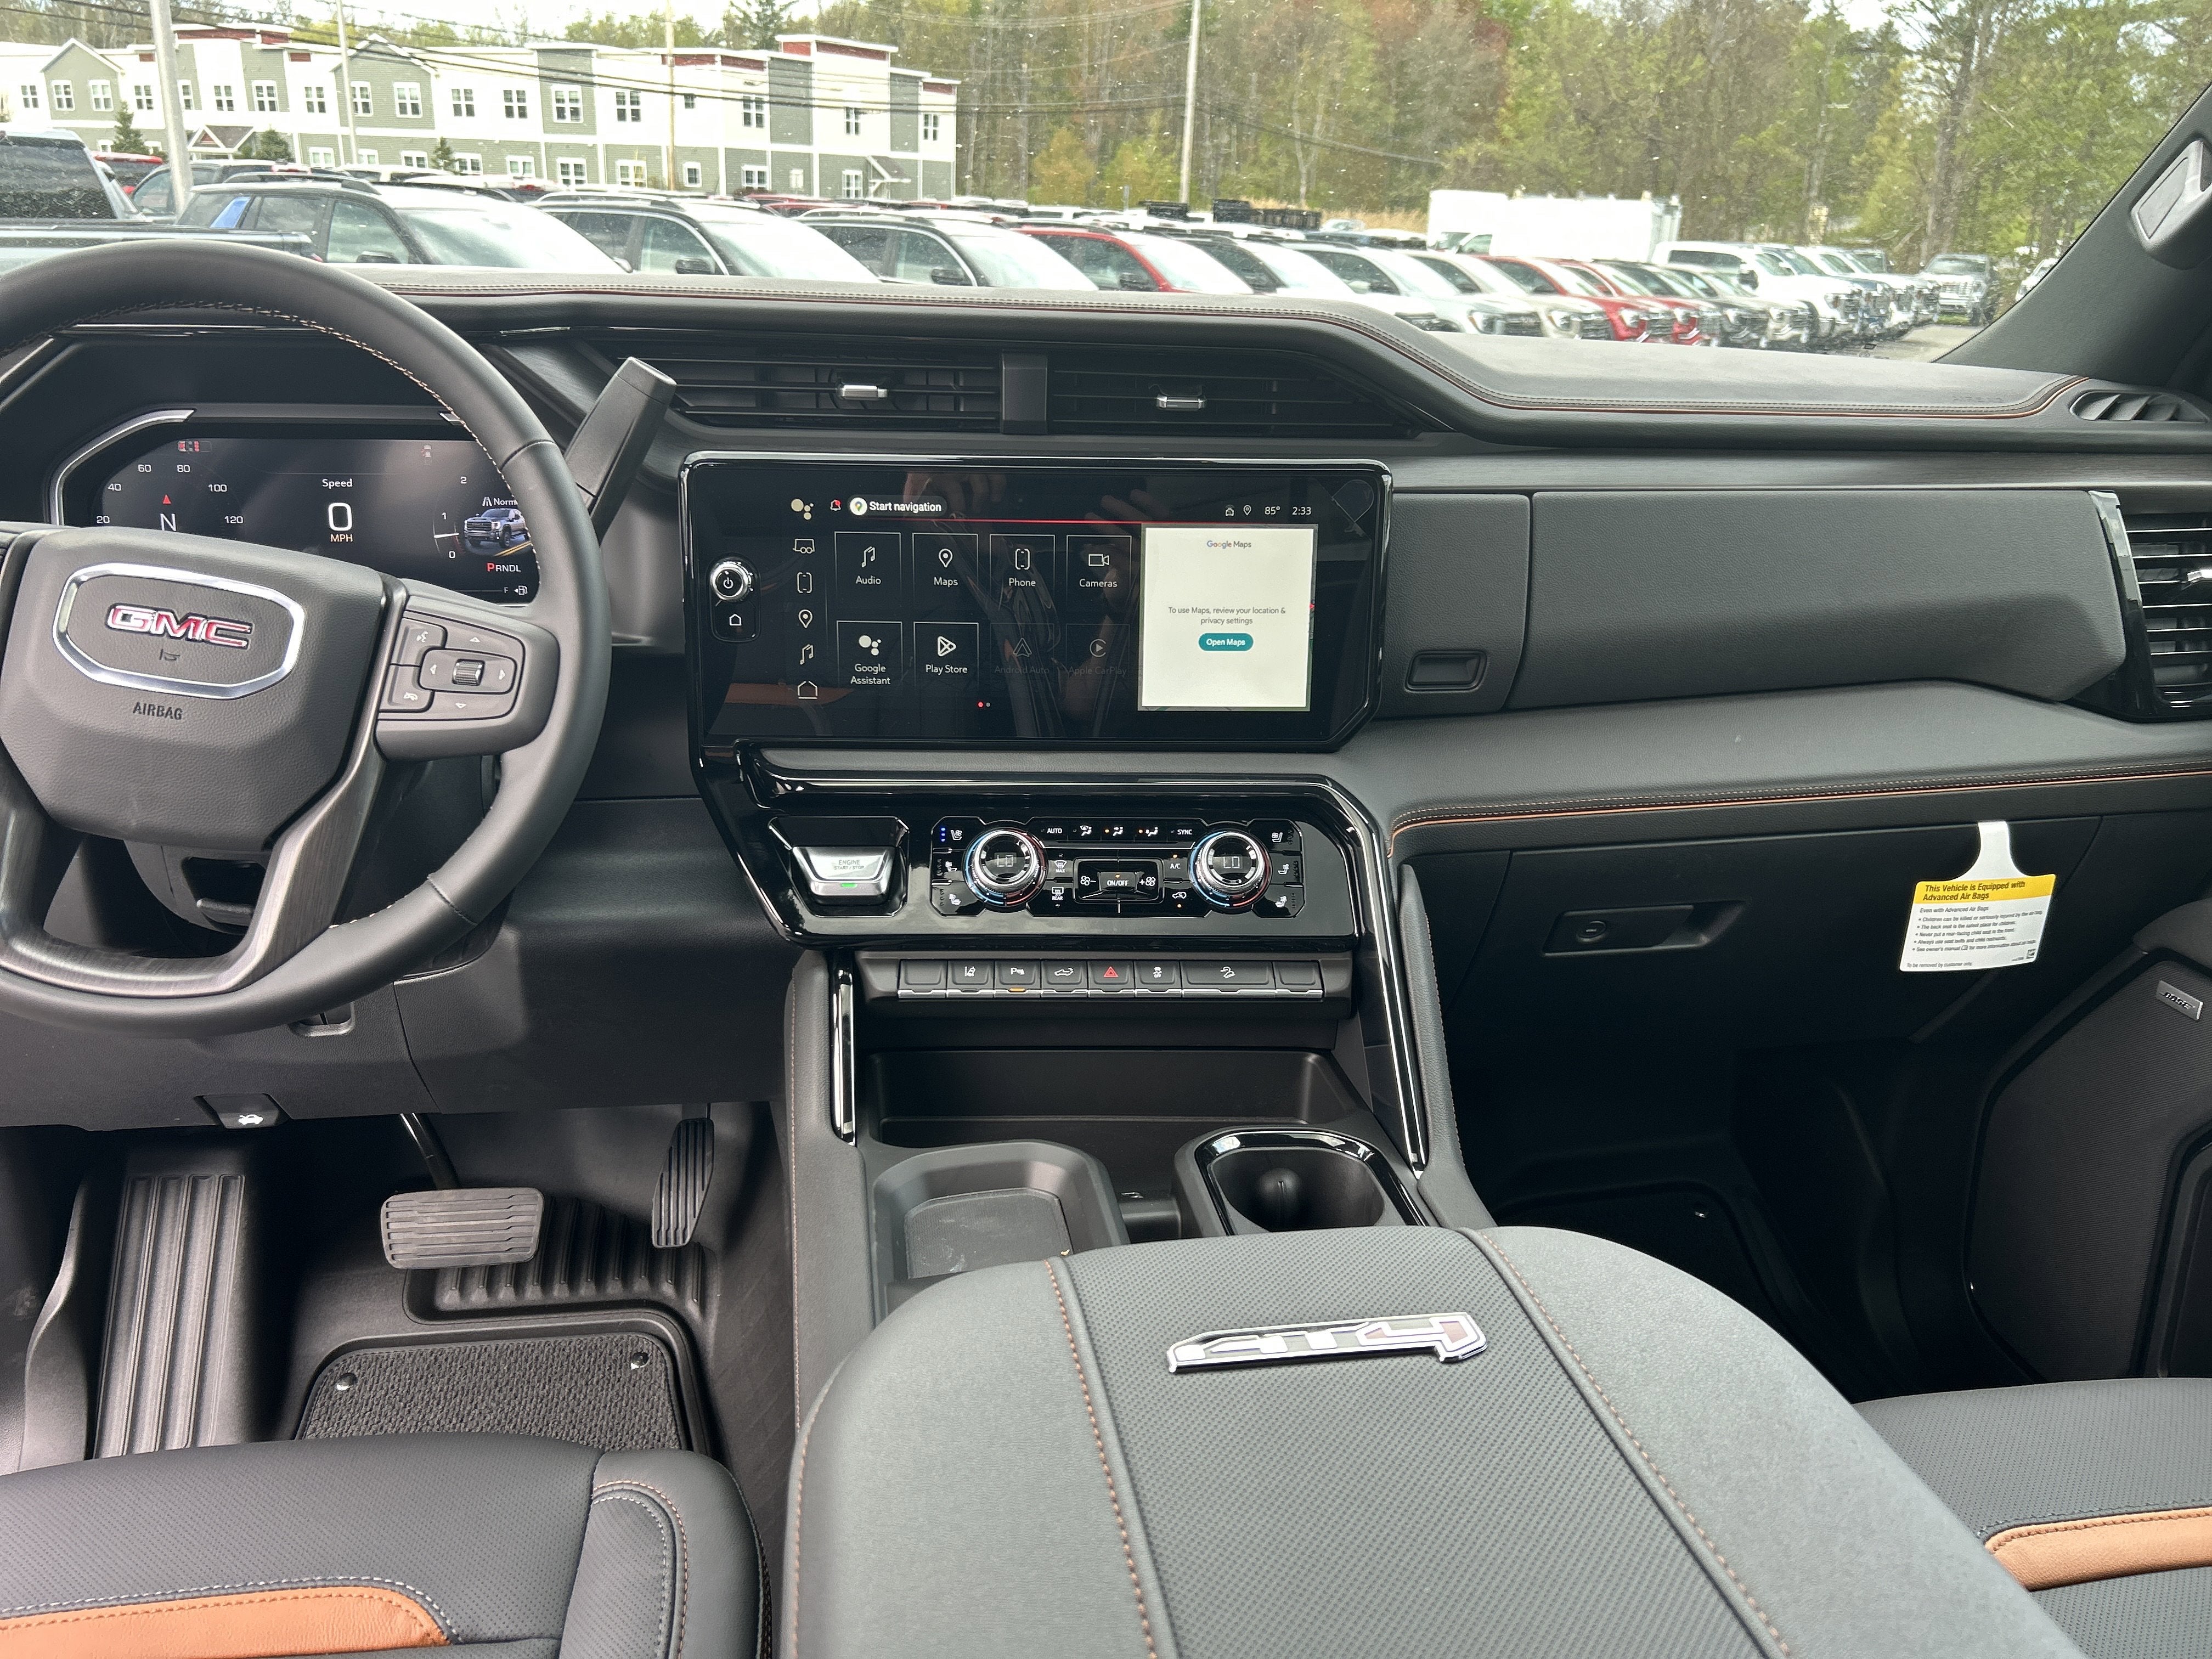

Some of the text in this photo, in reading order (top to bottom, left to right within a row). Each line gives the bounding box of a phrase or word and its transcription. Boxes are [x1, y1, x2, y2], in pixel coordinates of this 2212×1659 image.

[138, 464, 151, 472] 60
[108, 483, 122, 492] 40
[208, 484, 227, 492] 100
[322, 478, 353, 489] Speed
[869, 501, 942, 514] Start navigation
[1291, 506, 1312, 515] 2:33
[96, 516, 110, 524] 20
[224, 516, 244, 524] 120
[328, 503, 353, 531] 0
[160, 513, 177, 532] N
[330, 534, 353, 542] MPH
[1206, 540, 1252, 549] Google Maps
[448, 551, 456, 559] 0
[487, 562, 521, 572] PRNDL
[855, 575, 882, 585] Audio
[934, 577, 958, 588] Maps
[1008, 578, 1036, 587] Phone
[1079, 578, 1118, 588] Cameras
[1191, 607, 1211, 615] Maps,
[1200, 617, 1253, 625] privacy settings
[107, 604, 251, 648] GMC
[1206, 639, 1245, 647] Open Maps
[854, 663, 887, 675] Google
[926, 664, 968, 675] Play Store
[994, 665, 1050, 674] Android Auto
[1069, 666, 1127, 677] Apple CarPlay
[850, 676, 891, 685] Assistant
[133, 702, 184, 720] AIRBAG
[1978, 882, 2010, 891] Equipped
[1972, 892, 1990, 900] Bags
[1167, 1312, 1488, 1373] AT4
